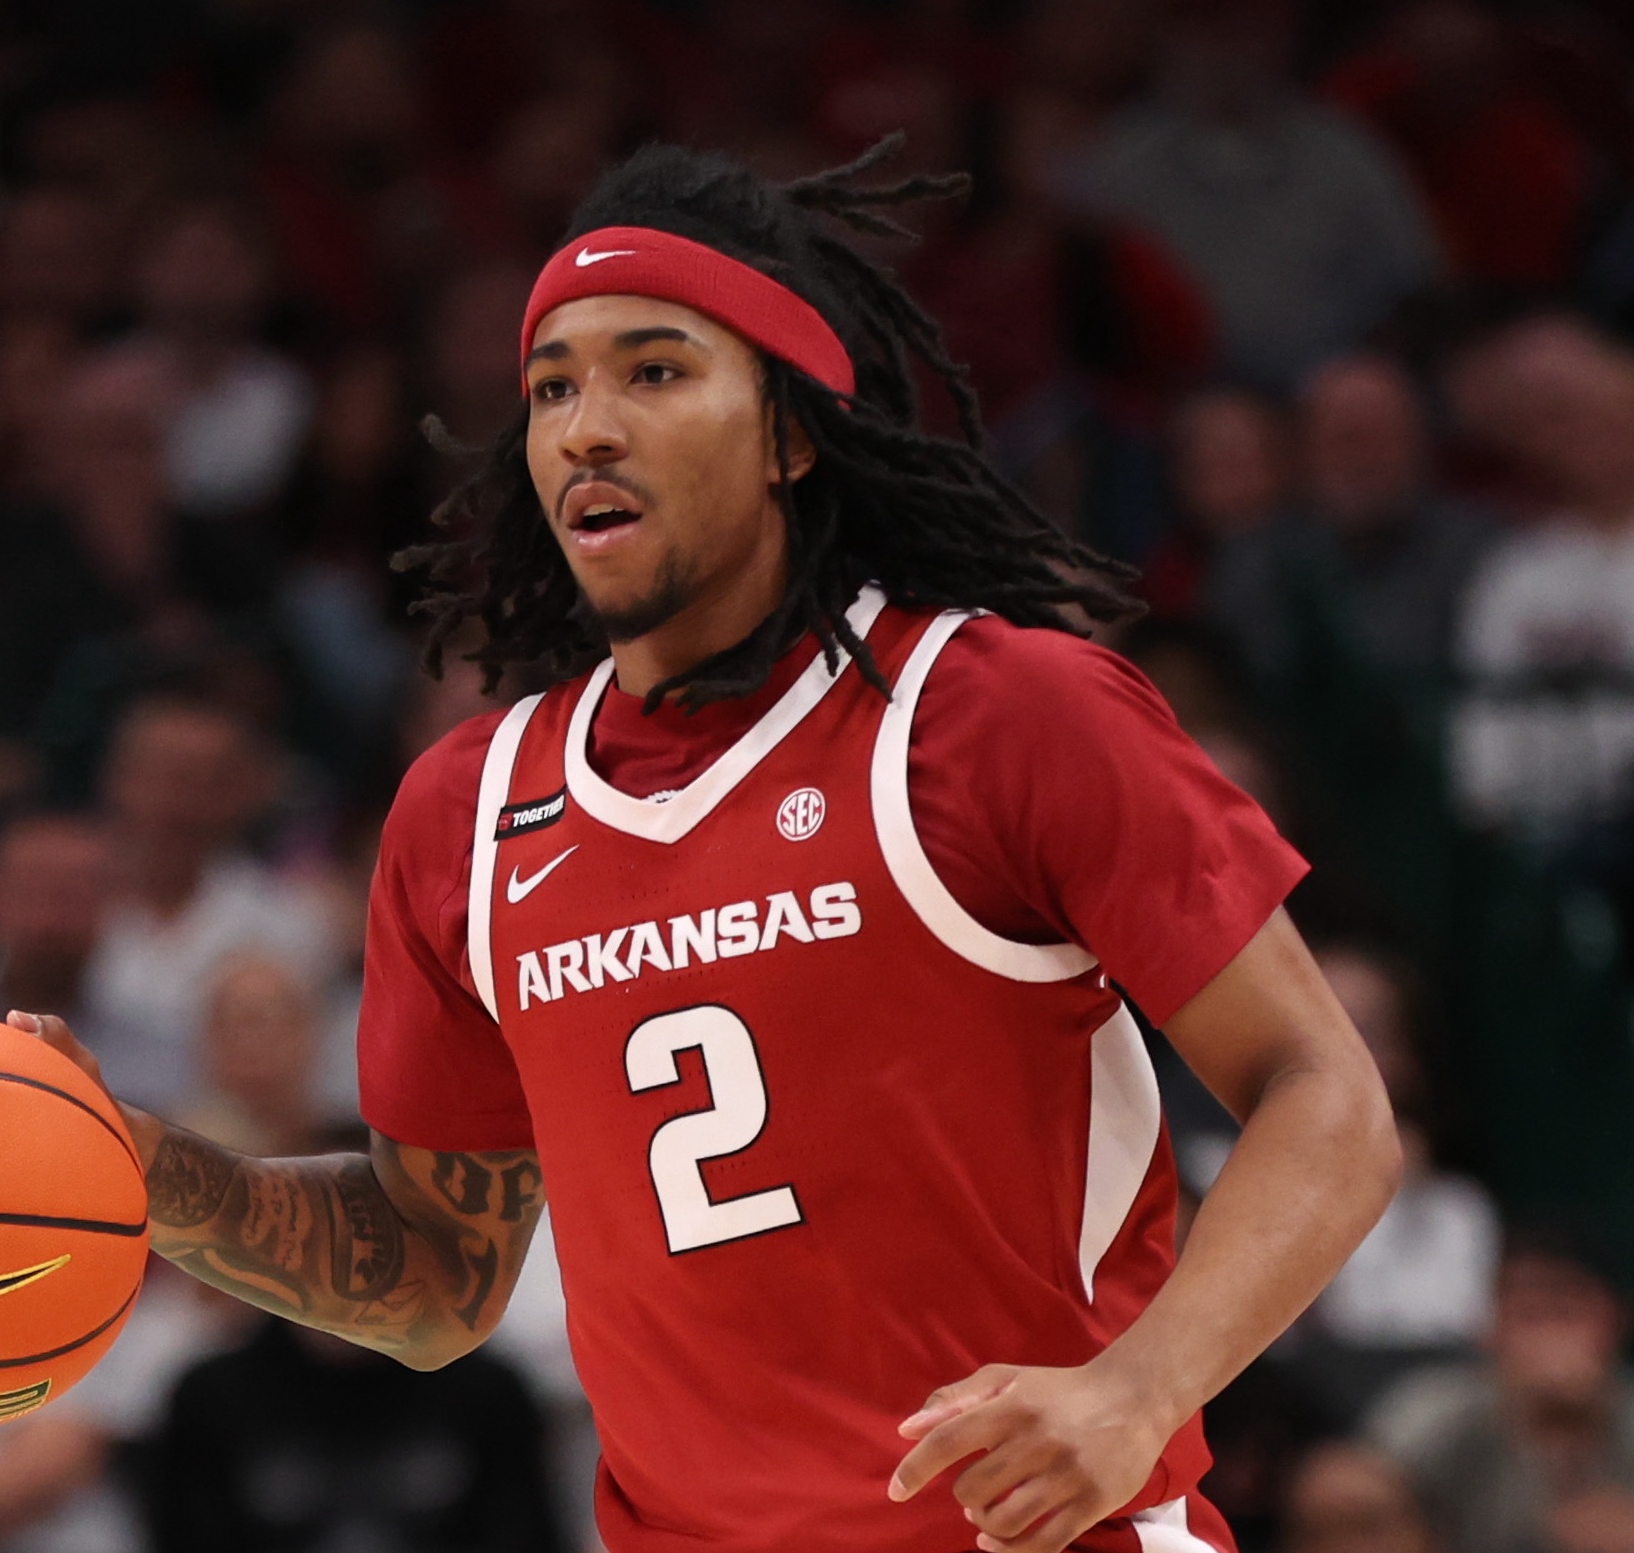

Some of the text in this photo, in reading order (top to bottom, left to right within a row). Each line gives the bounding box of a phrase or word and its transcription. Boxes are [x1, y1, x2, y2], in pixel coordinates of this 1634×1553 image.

[781, 792, 821, 836] SEC
[515, 881, 862, 1012] ARKANSAS
[624, 1003, 805, 1254] 2
